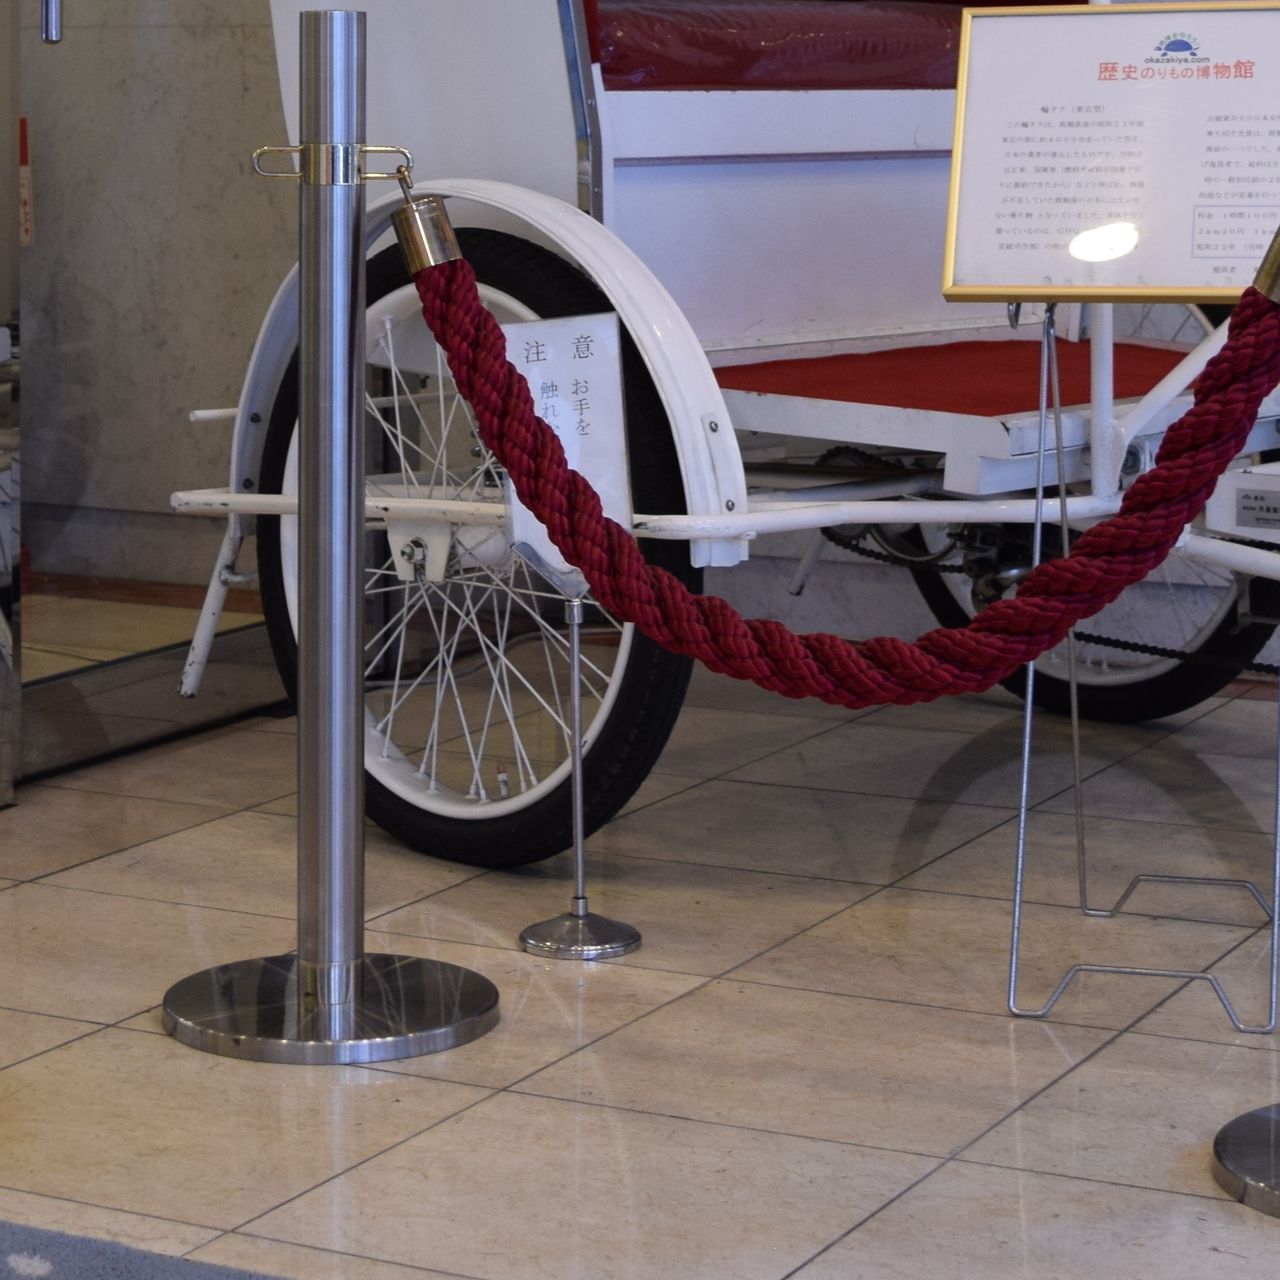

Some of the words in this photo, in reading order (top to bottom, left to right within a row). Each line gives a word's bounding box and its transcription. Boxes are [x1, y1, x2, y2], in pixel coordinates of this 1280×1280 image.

[1144, 56, 1210, 65] okazakiya.com
[1097, 61, 1255, 81] 歴史のりもの博物館
[570, 378, 592, 437] お手を
